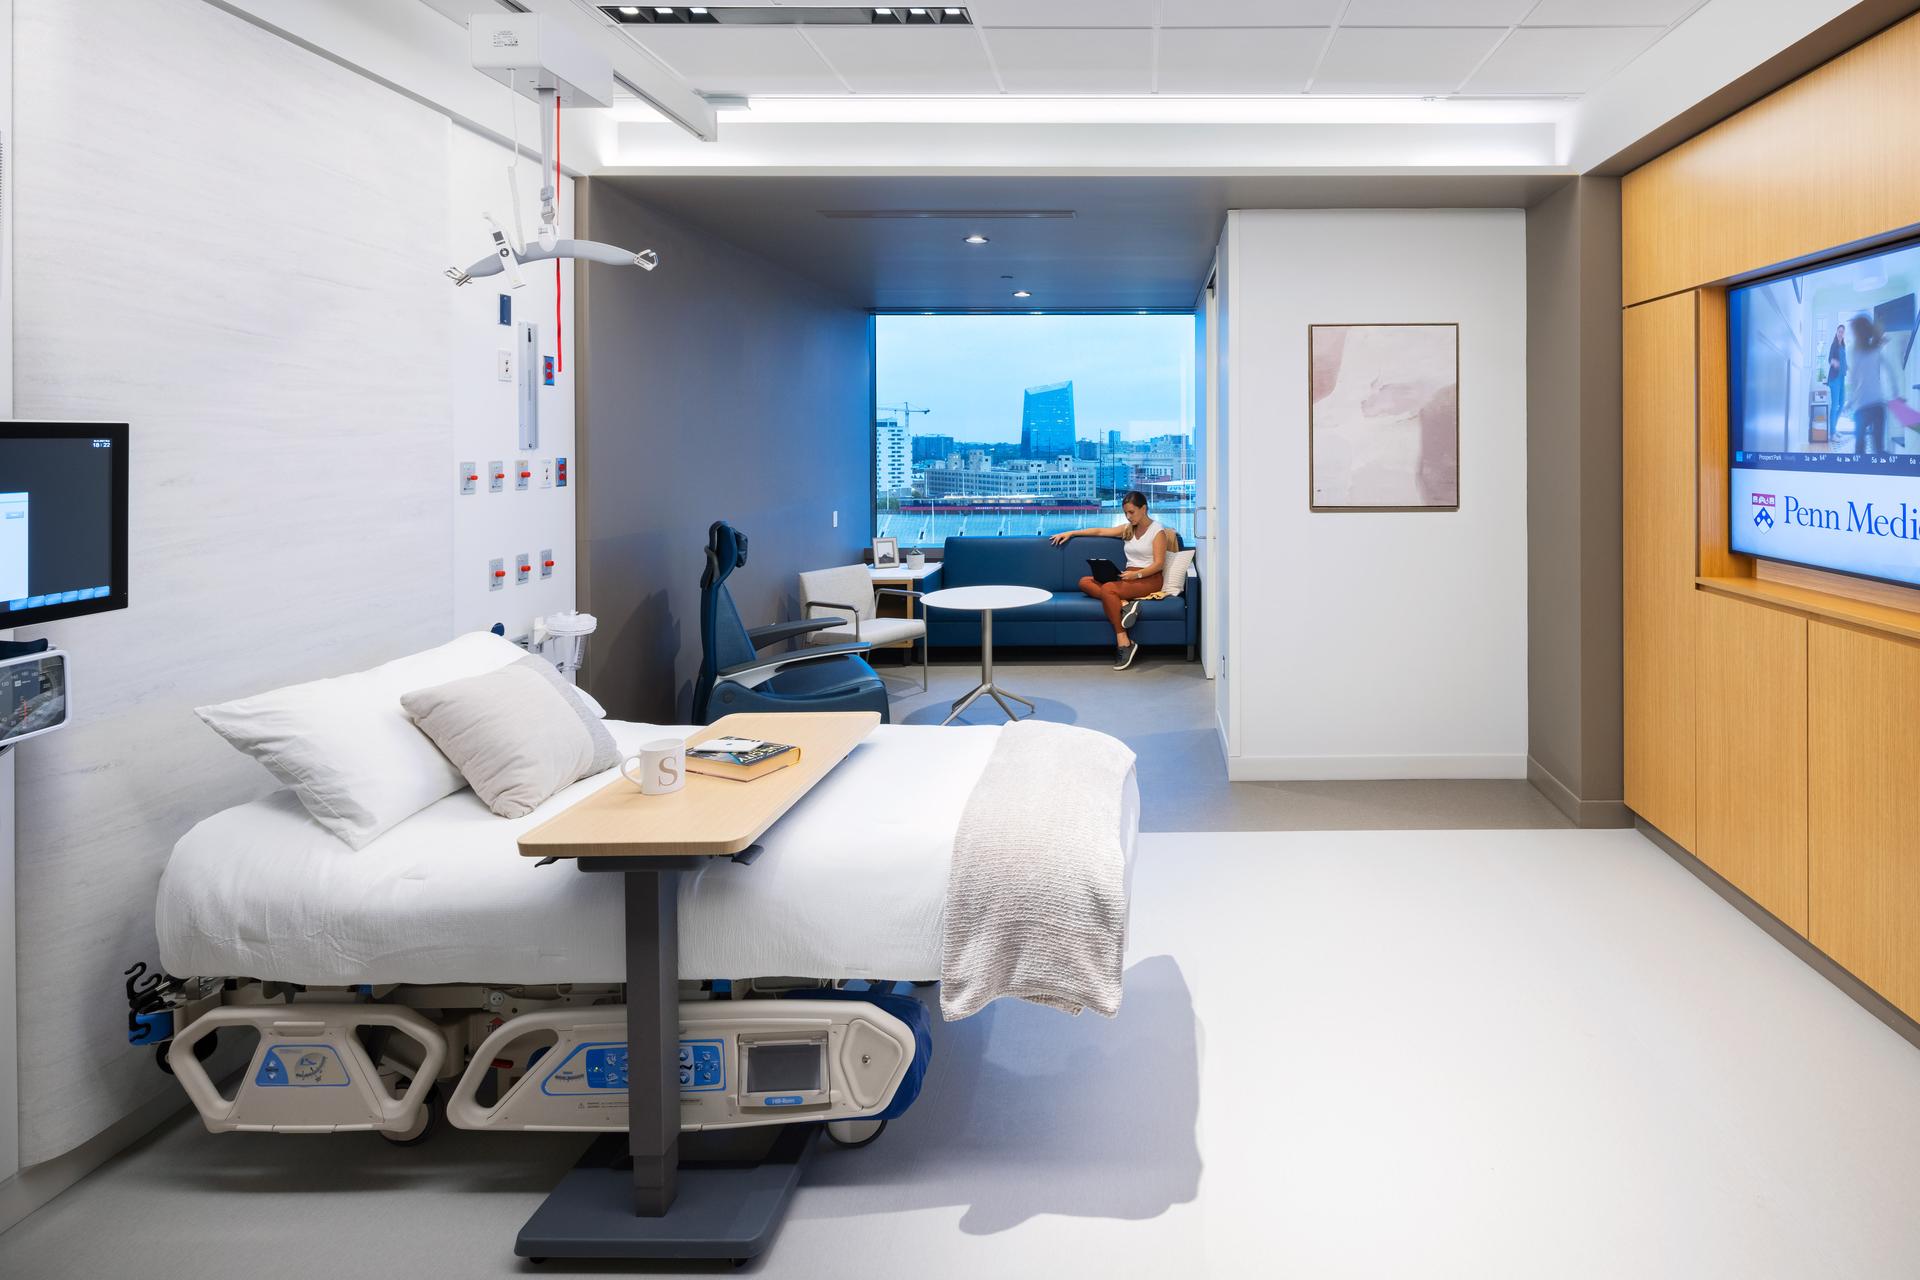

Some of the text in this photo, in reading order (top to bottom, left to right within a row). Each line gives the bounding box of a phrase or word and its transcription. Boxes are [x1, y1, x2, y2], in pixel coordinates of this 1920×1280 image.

[1784, 496, 1920, 540] Penn Medi
[658, 756, 678, 786] S
